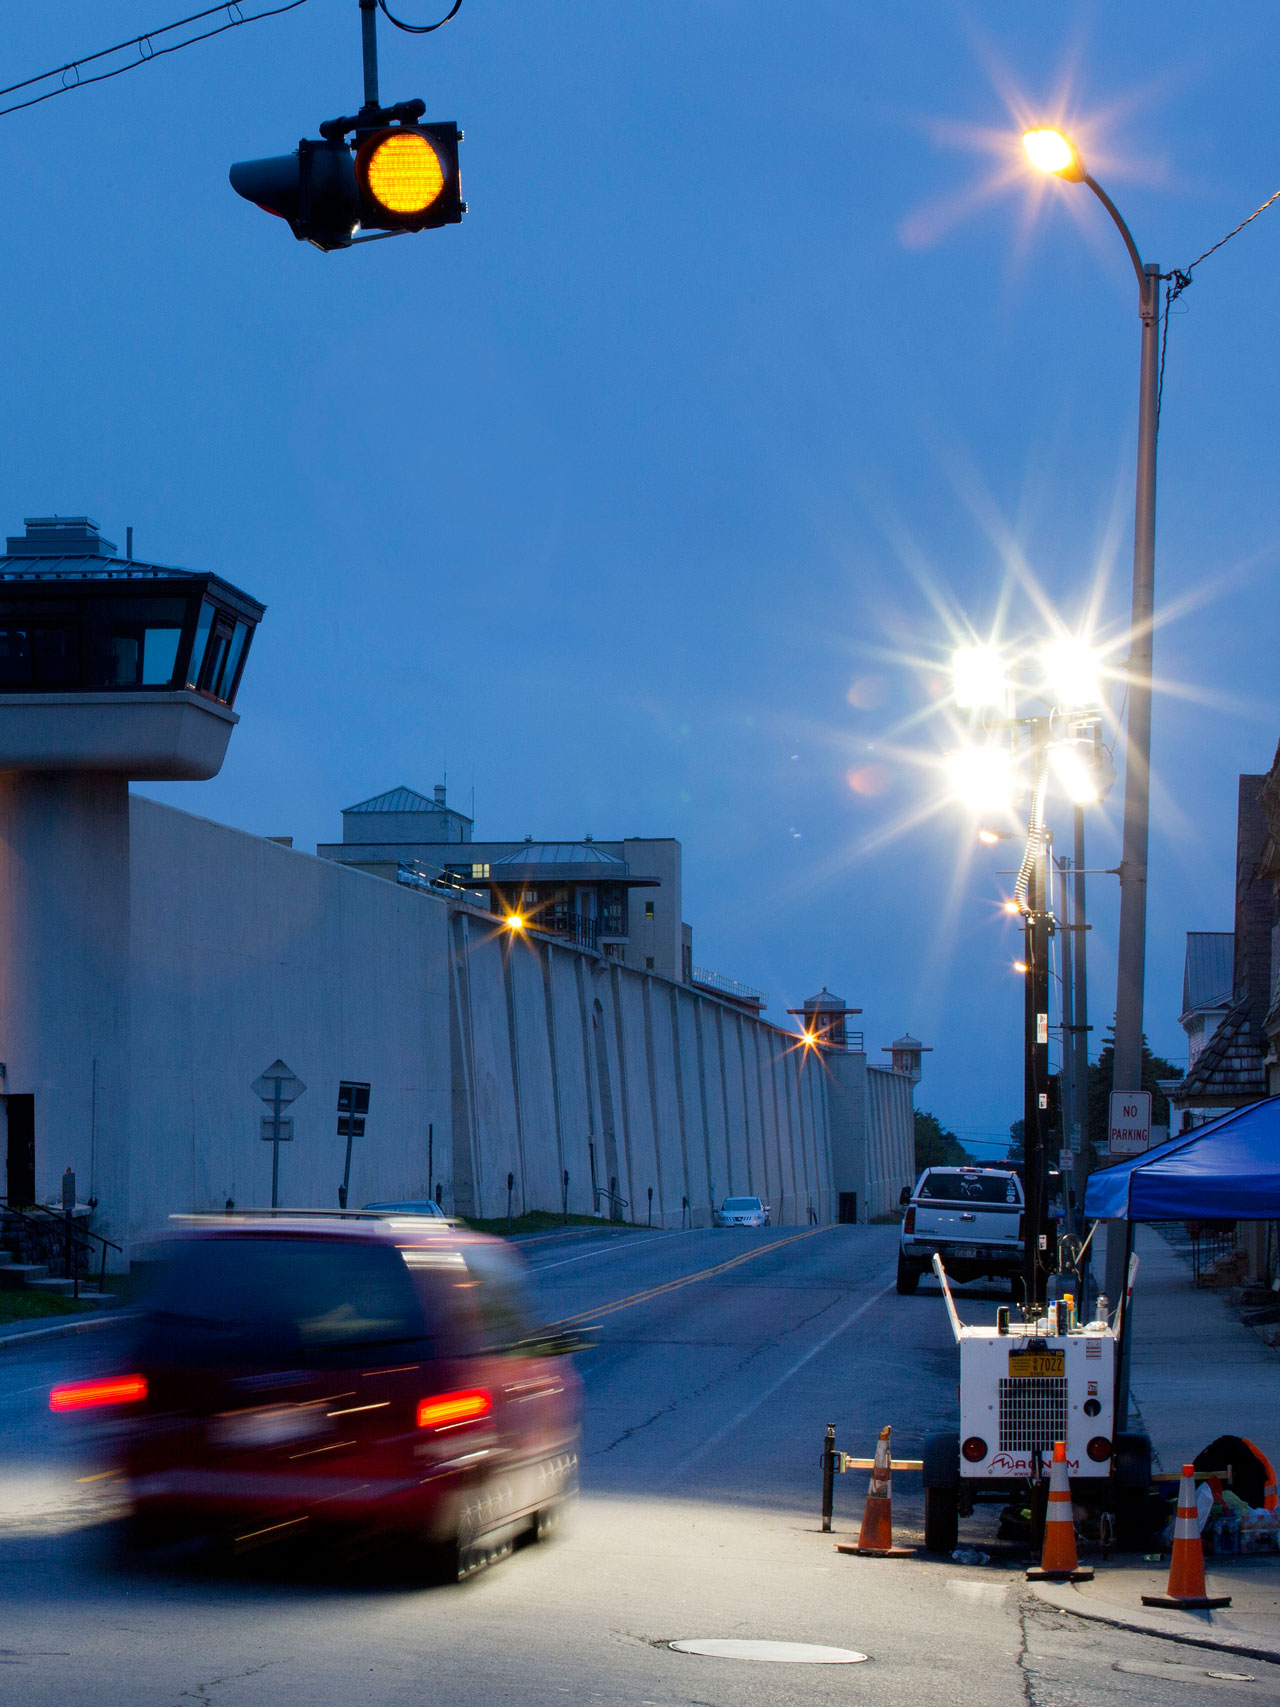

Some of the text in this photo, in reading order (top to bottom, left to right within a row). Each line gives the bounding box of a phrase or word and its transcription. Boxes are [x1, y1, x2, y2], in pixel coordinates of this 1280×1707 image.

[1123, 1105, 1138, 1118] NO
[1111, 1128, 1148, 1141] PARKING
[1039, 1357, 1063, 1372] 7022
